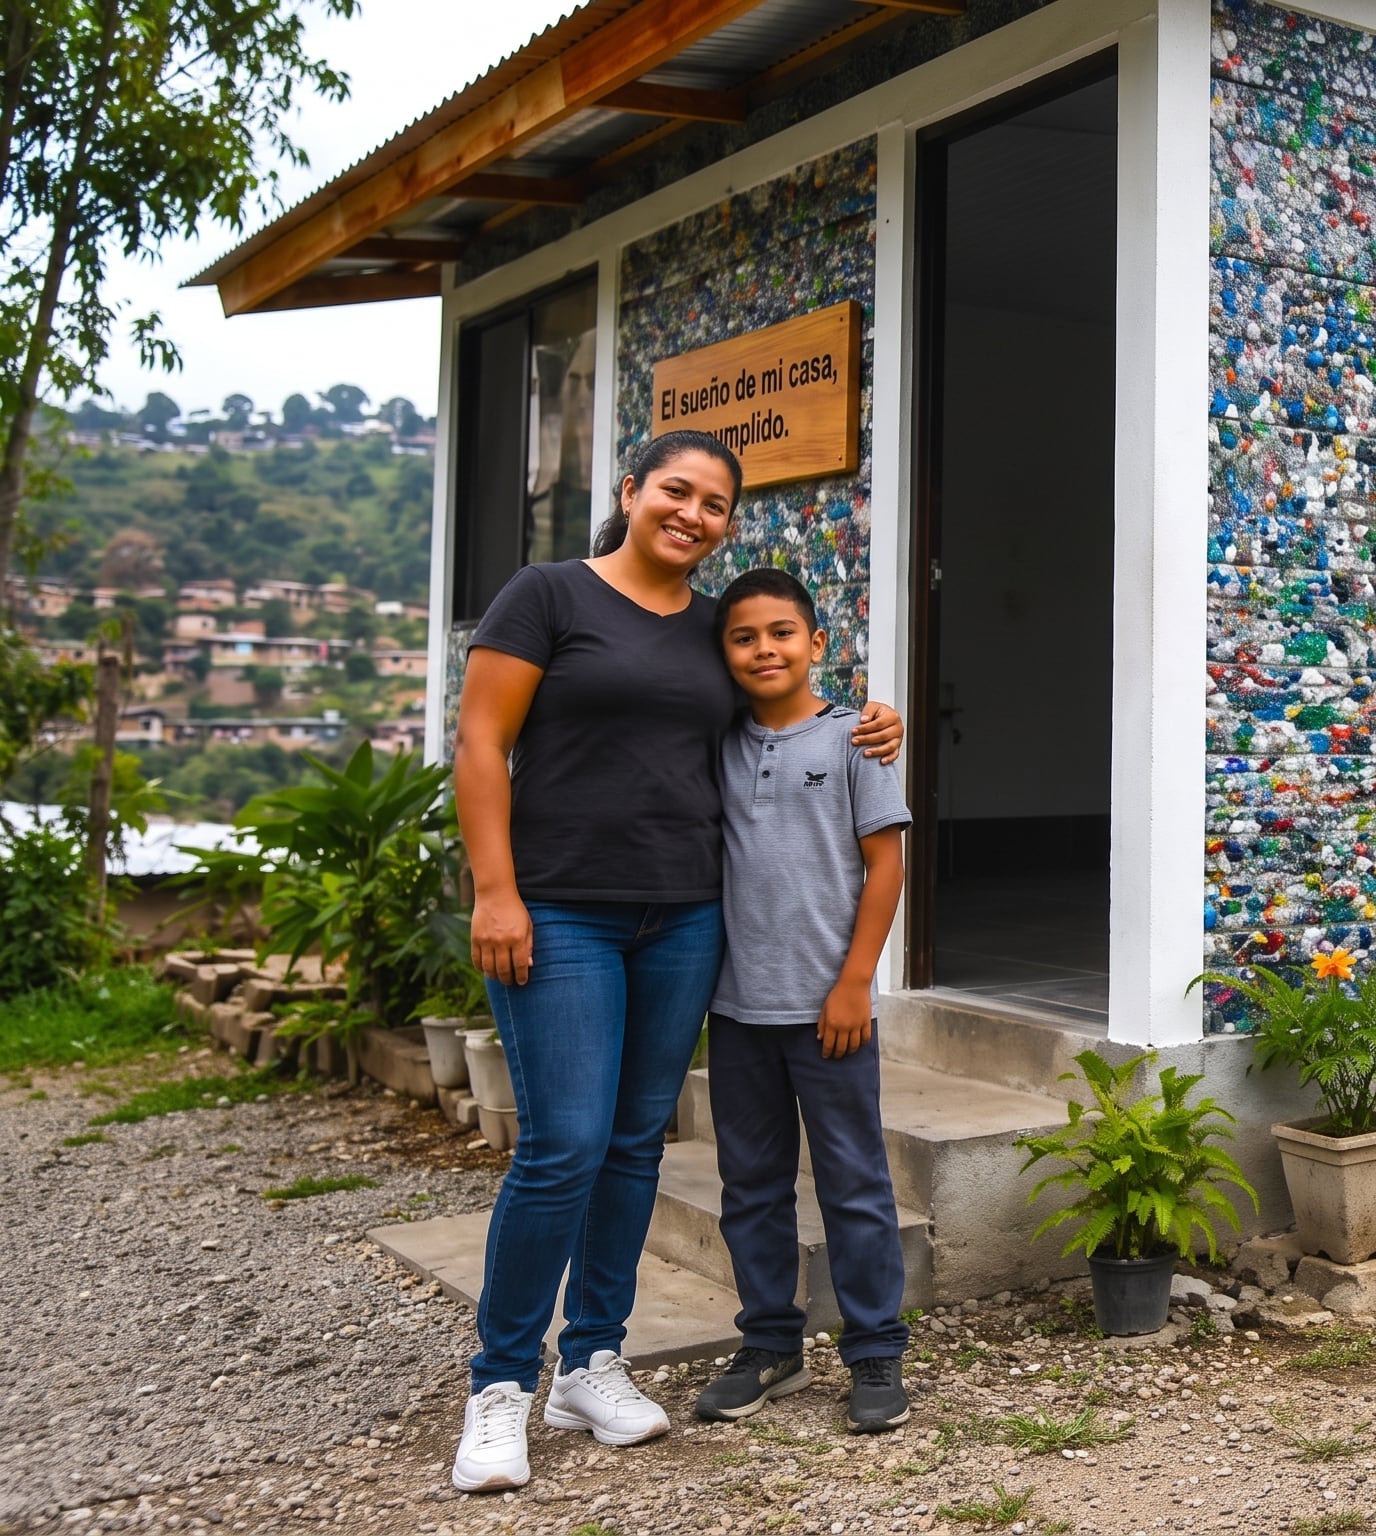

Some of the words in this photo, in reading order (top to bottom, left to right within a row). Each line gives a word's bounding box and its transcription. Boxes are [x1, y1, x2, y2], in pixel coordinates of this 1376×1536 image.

[661, 388, 676, 421] El
[680, 376, 730, 415] sueño
[735, 368, 756, 401] de
[761, 358, 783, 395] mi
[788, 353, 838, 387] casa,
[706, 408, 789, 456] umplido.
